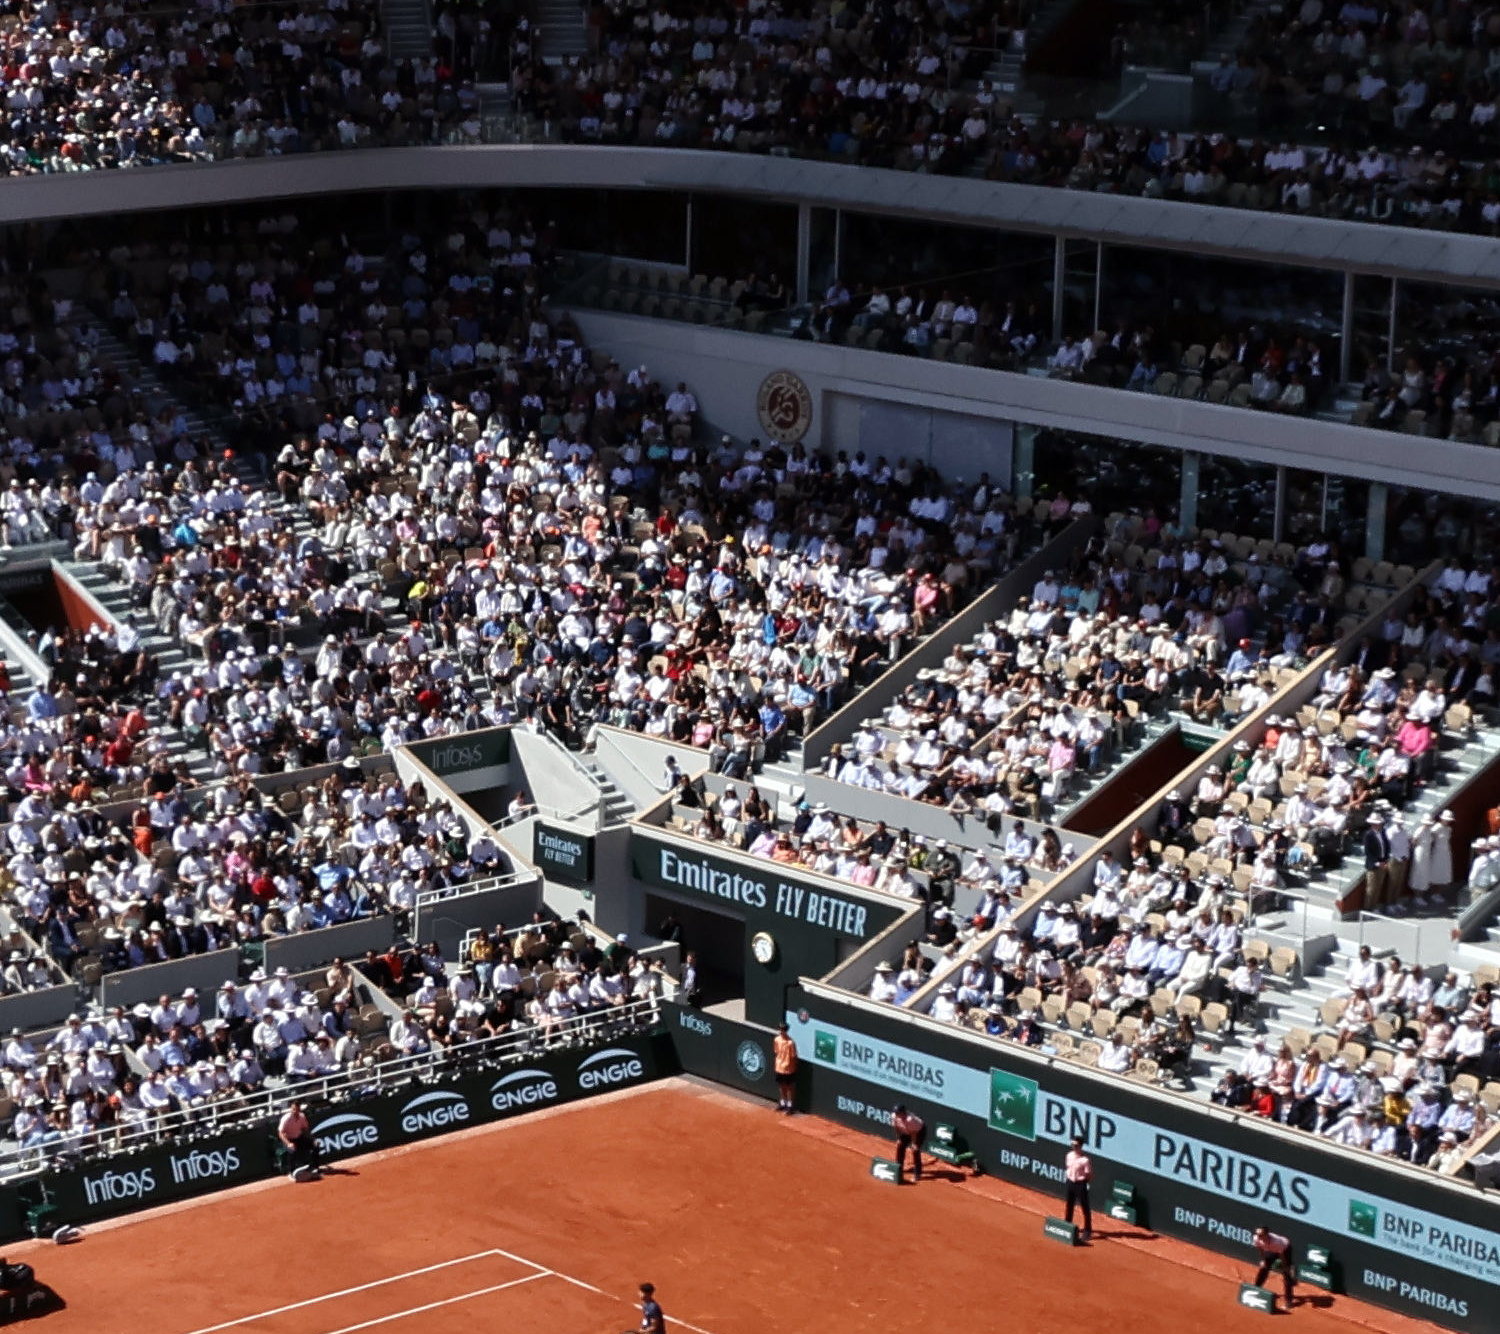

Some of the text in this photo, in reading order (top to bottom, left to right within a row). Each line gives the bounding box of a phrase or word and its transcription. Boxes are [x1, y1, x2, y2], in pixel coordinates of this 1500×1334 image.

[432, 744, 483, 770] Infosys
[537, 830, 583, 857] Emirates
[660, 849, 867, 938] Emirates FLY BETTER
[679, 1013, 712, 1037] Infosys
[842, 1040, 944, 1088] BNP PARIBAS
[837, 1095, 864, 1116] BNP
[171, 1145, 240, 1185] Infosys
[1000, 1149, 1030, 1170] BNP
[1044, 1098, 1311, 1216] BNP PARIBAS
[83, 1166, 156, 1206] Infosys
[1174, 1206, 1254, 1247] BNP PARIB
[1383, 1212, 1424, 1239] BNP
[1363, 1268, 1470, 1318] BNP PARIBAS
